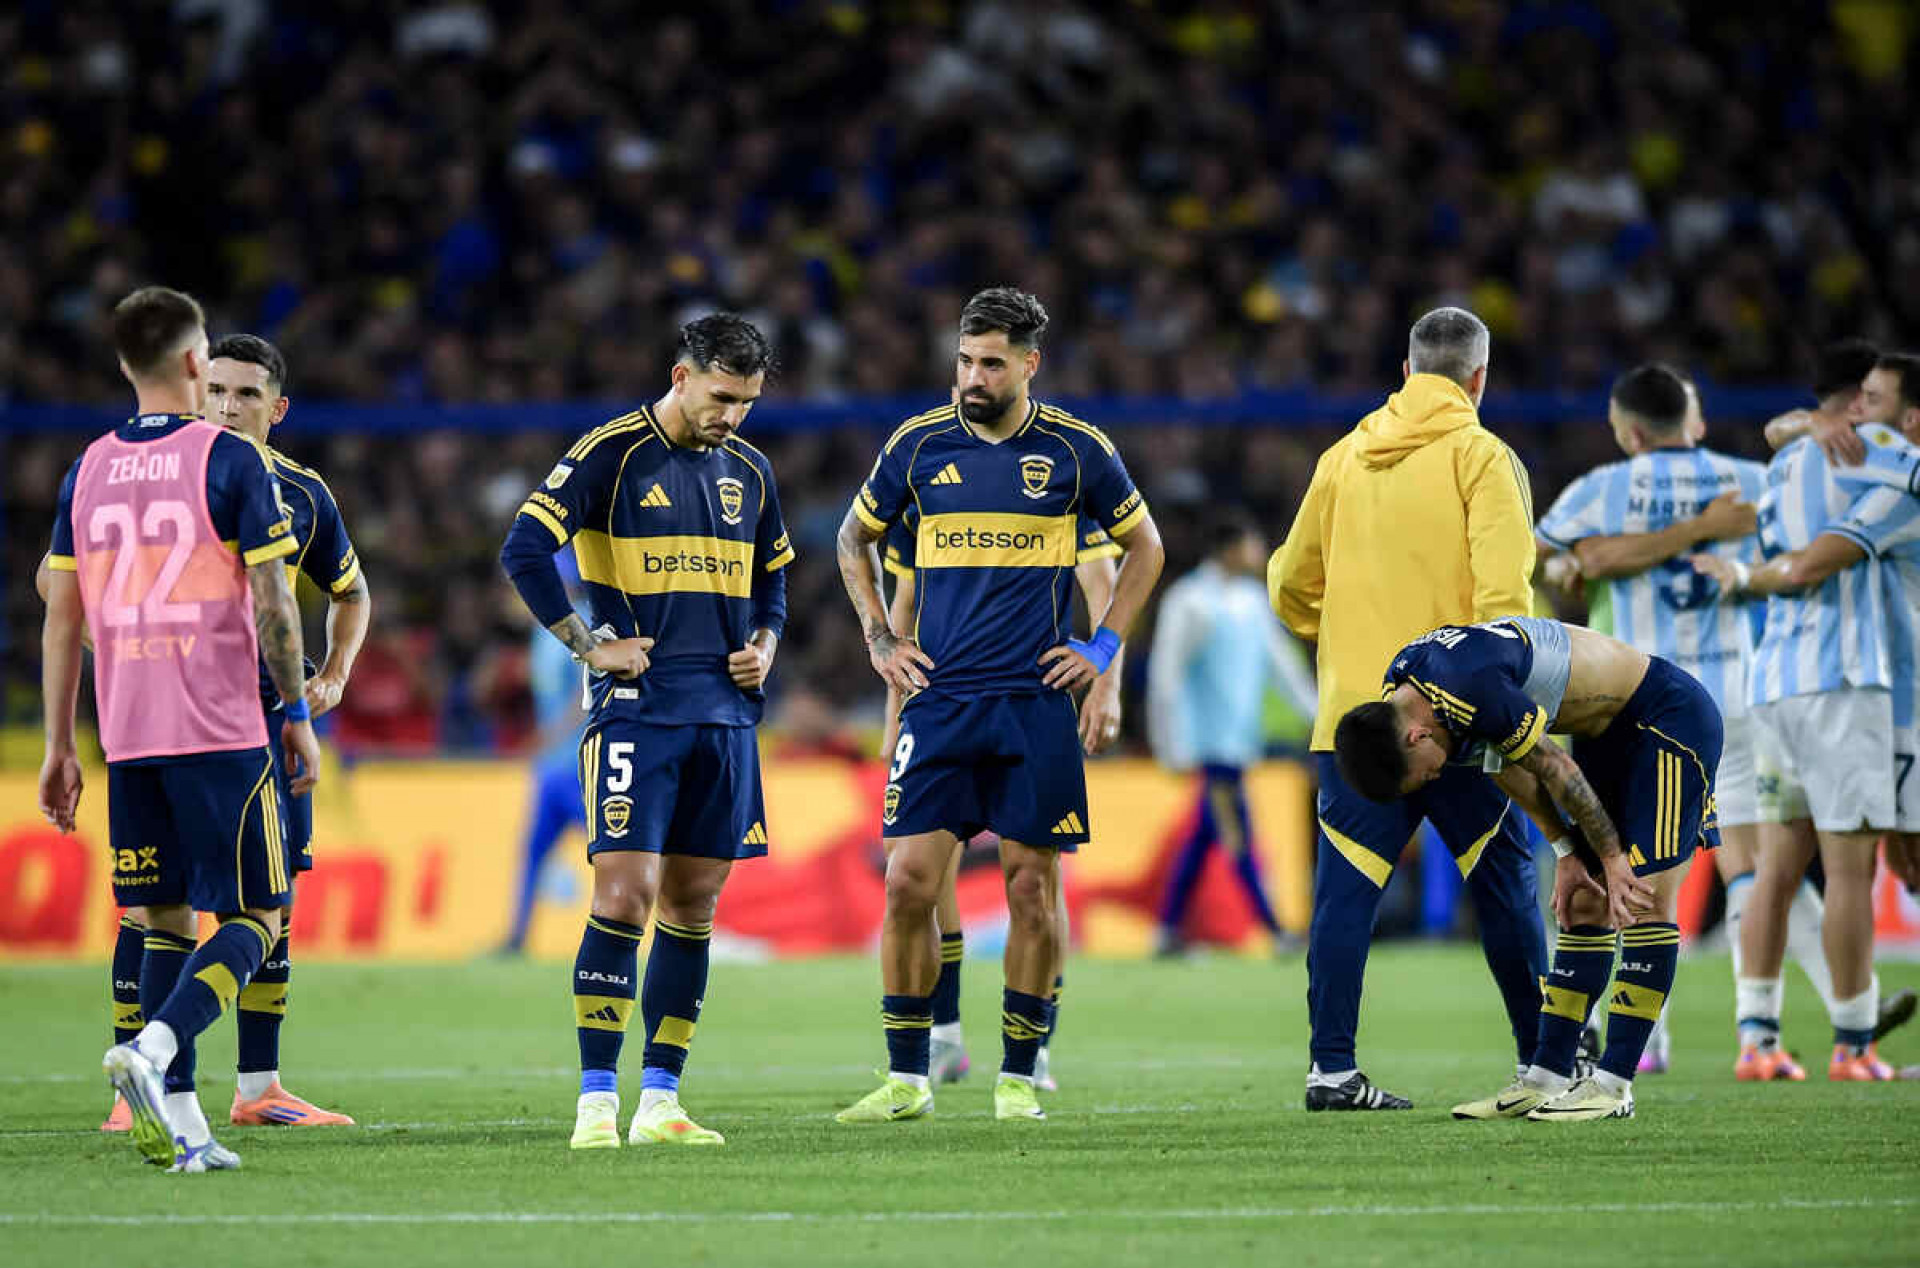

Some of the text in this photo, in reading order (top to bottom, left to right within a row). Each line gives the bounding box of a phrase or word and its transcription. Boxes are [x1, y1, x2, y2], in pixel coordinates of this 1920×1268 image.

[643, 549, 745, 577] betsson
[934, 526, 1045, 551] betsson
[87, 500, 202, 628] 22
[606, 741, 636, 793] 5
[890, 733, 916, 783] 9
